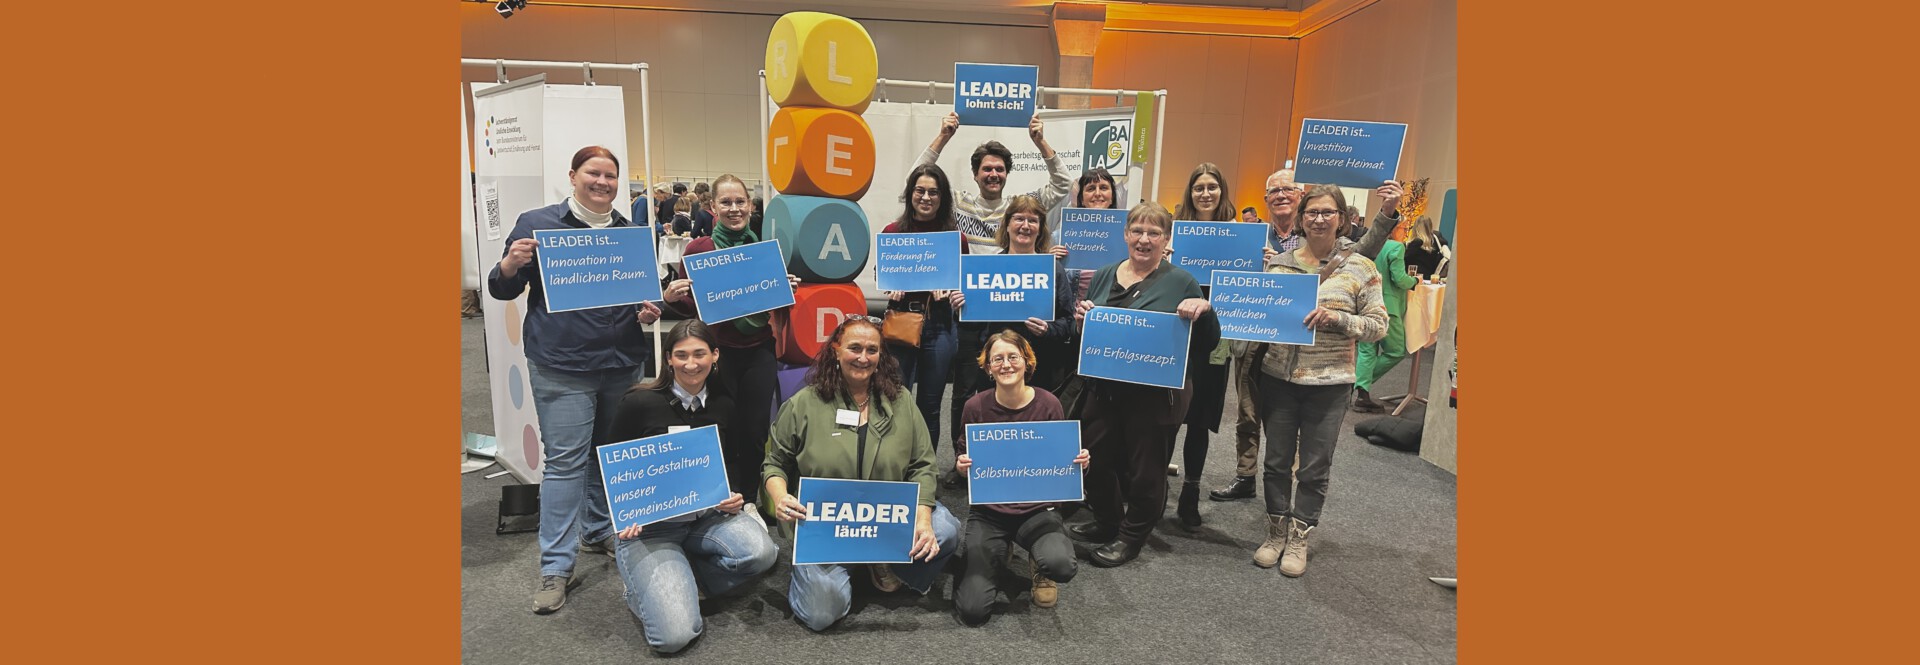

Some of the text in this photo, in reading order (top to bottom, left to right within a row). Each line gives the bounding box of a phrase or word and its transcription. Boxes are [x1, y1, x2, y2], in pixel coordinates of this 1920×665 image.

[828, 40, 853, 85] L
[960, 81, 1032, 98] LEADER
[965, 98, 1024, 110] lohnt sich!
[1110, 125, 1128, 142] BA
[1306, 124, 1371, 138] LEADER ist...
[1108, 142, 1122, 160] G
[1303, 140, 1353, 153] Investition
[825, 134, 854, 177] E
[1088, 154, 1105, 170] LA
[1300, 154, 1385, 170] in unsere Heimat.
[1065, 212, 1122, 224] LEADER ist...
[1064, 228, 1109, 238] ein starkes
[1177, 226, 1237, 237] LEADER ist...
[542, 234, 619, 248] LEADER ist...
[818, 223, 852, 261] A
[880, 238, 934, 247] LEADER ist...
[1064, 242, 1108, 252] Netzwerk.
[546, 253, 623, 268] Innovation im
[690, 252, 752, 271] LEADER ist...
[880, 250, 937, 262] Förderung für
[1180, 256, 1216, 268] Europa
[1233, 258, 1253, 268] Ort.
[880, 264, 939, 273] kreative Ideen.
[550, 270, 648, 286] ländlichen Raum.
[966, 273, 1049, 290] LEADER
[1216, 276, 1283, 289] LEADER ist...
[706, 278, 780, 302] Europa vor Ort.
[990, 291, 1025, 302] läuft!
[1214, 292, 1294, 306] die Zukunft der
[816, 307, 846, 343] D
[1090, 311, 1155, 328] LEADER ist...
[1220, 322, 1280, 338] ntwicklung.
[1085, 344, 1176, 367] ein Erfolgsrezept.
[972, 428, 1044, 442] LEADER ist...
[605, 440, 683, 464] LEADER ist...
[610, 454, 710, 485] aktive Gestaltung
[973, 464, 1076, 480] Selbstwirksamkeit.
[614, 485, 657, 504] unserer
[618, 490, 700, 522] Gemeinschaft.
[805, 501, 910, 524] LEADER
[834, 524, 879, 538] läuft!
